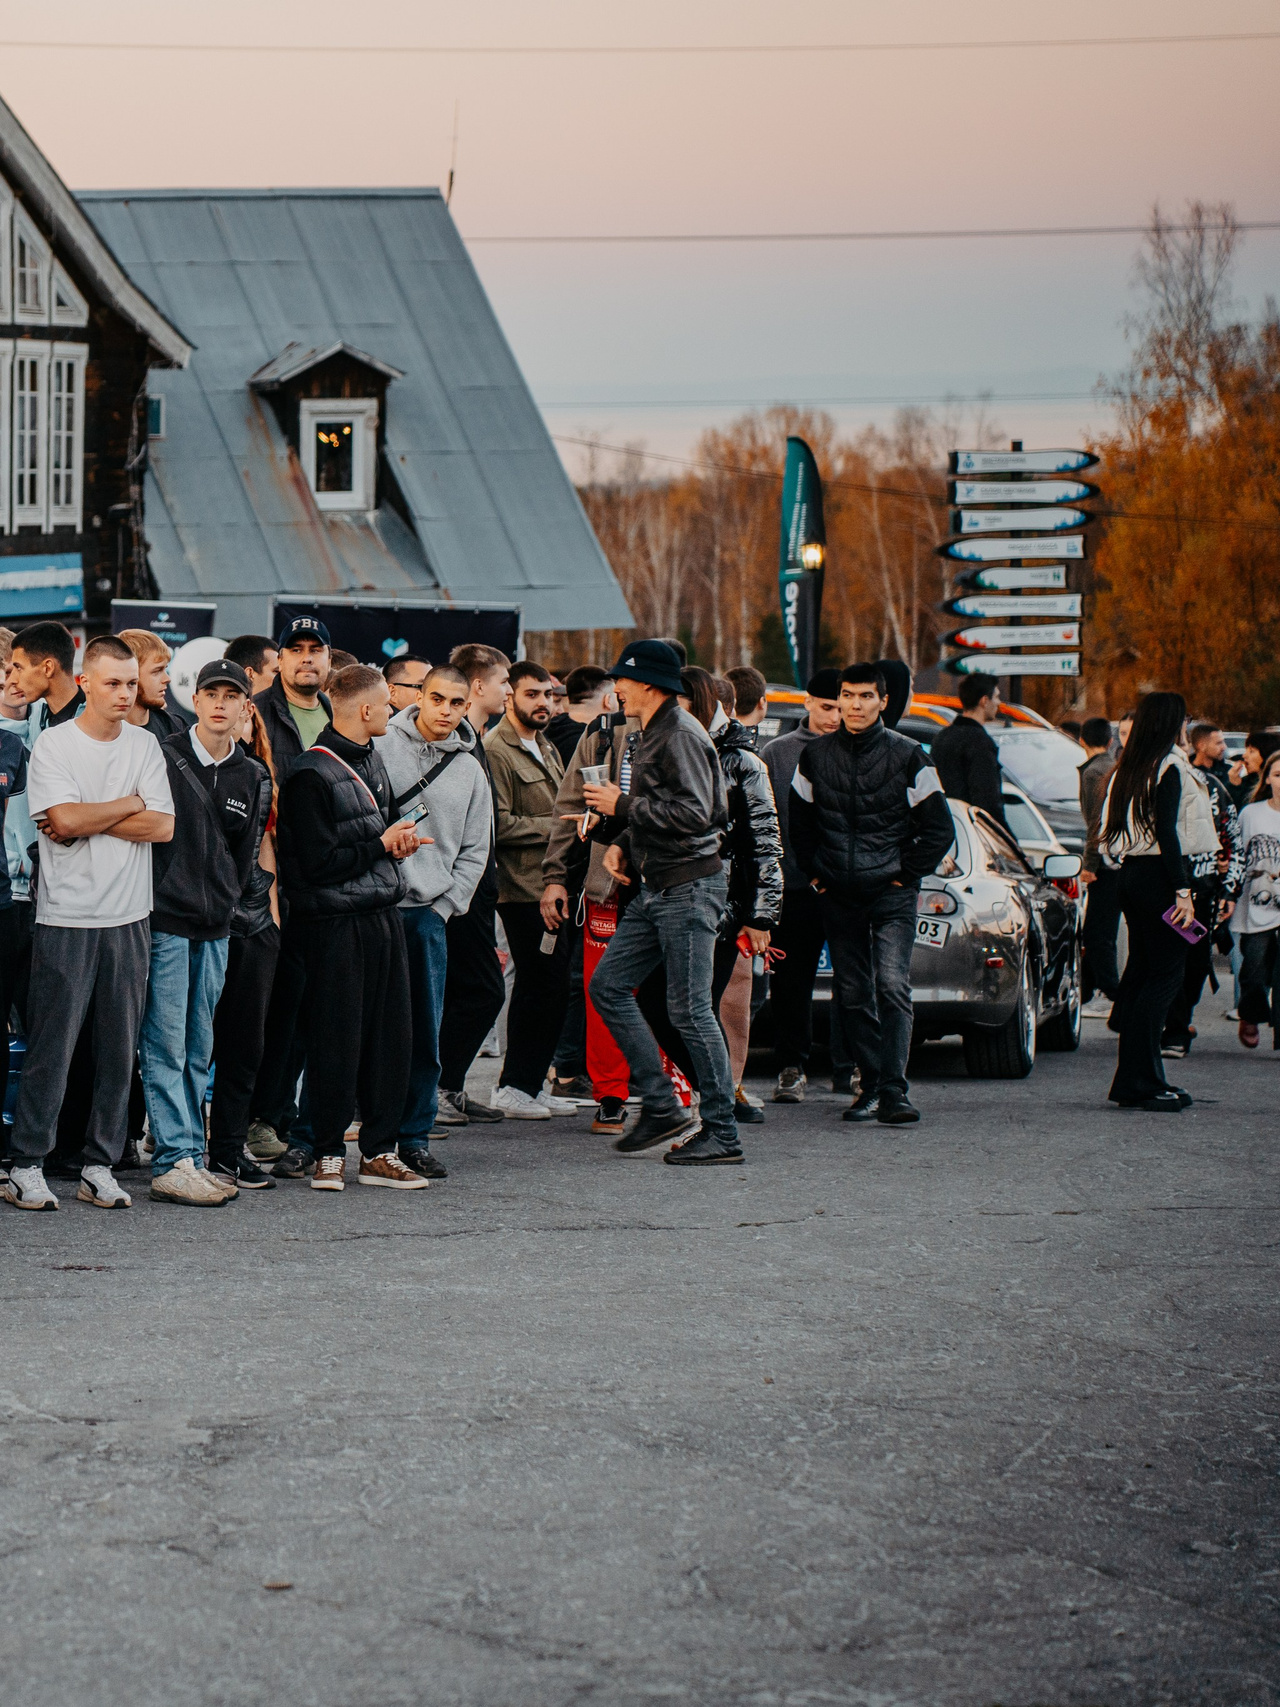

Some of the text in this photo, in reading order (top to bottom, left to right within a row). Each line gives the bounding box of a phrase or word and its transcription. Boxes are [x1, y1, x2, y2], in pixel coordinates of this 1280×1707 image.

[291, 618, 319, 632] FBI
[591, 920, 616, 929] VINTAGE
[918, 920, 940, 937] 03
